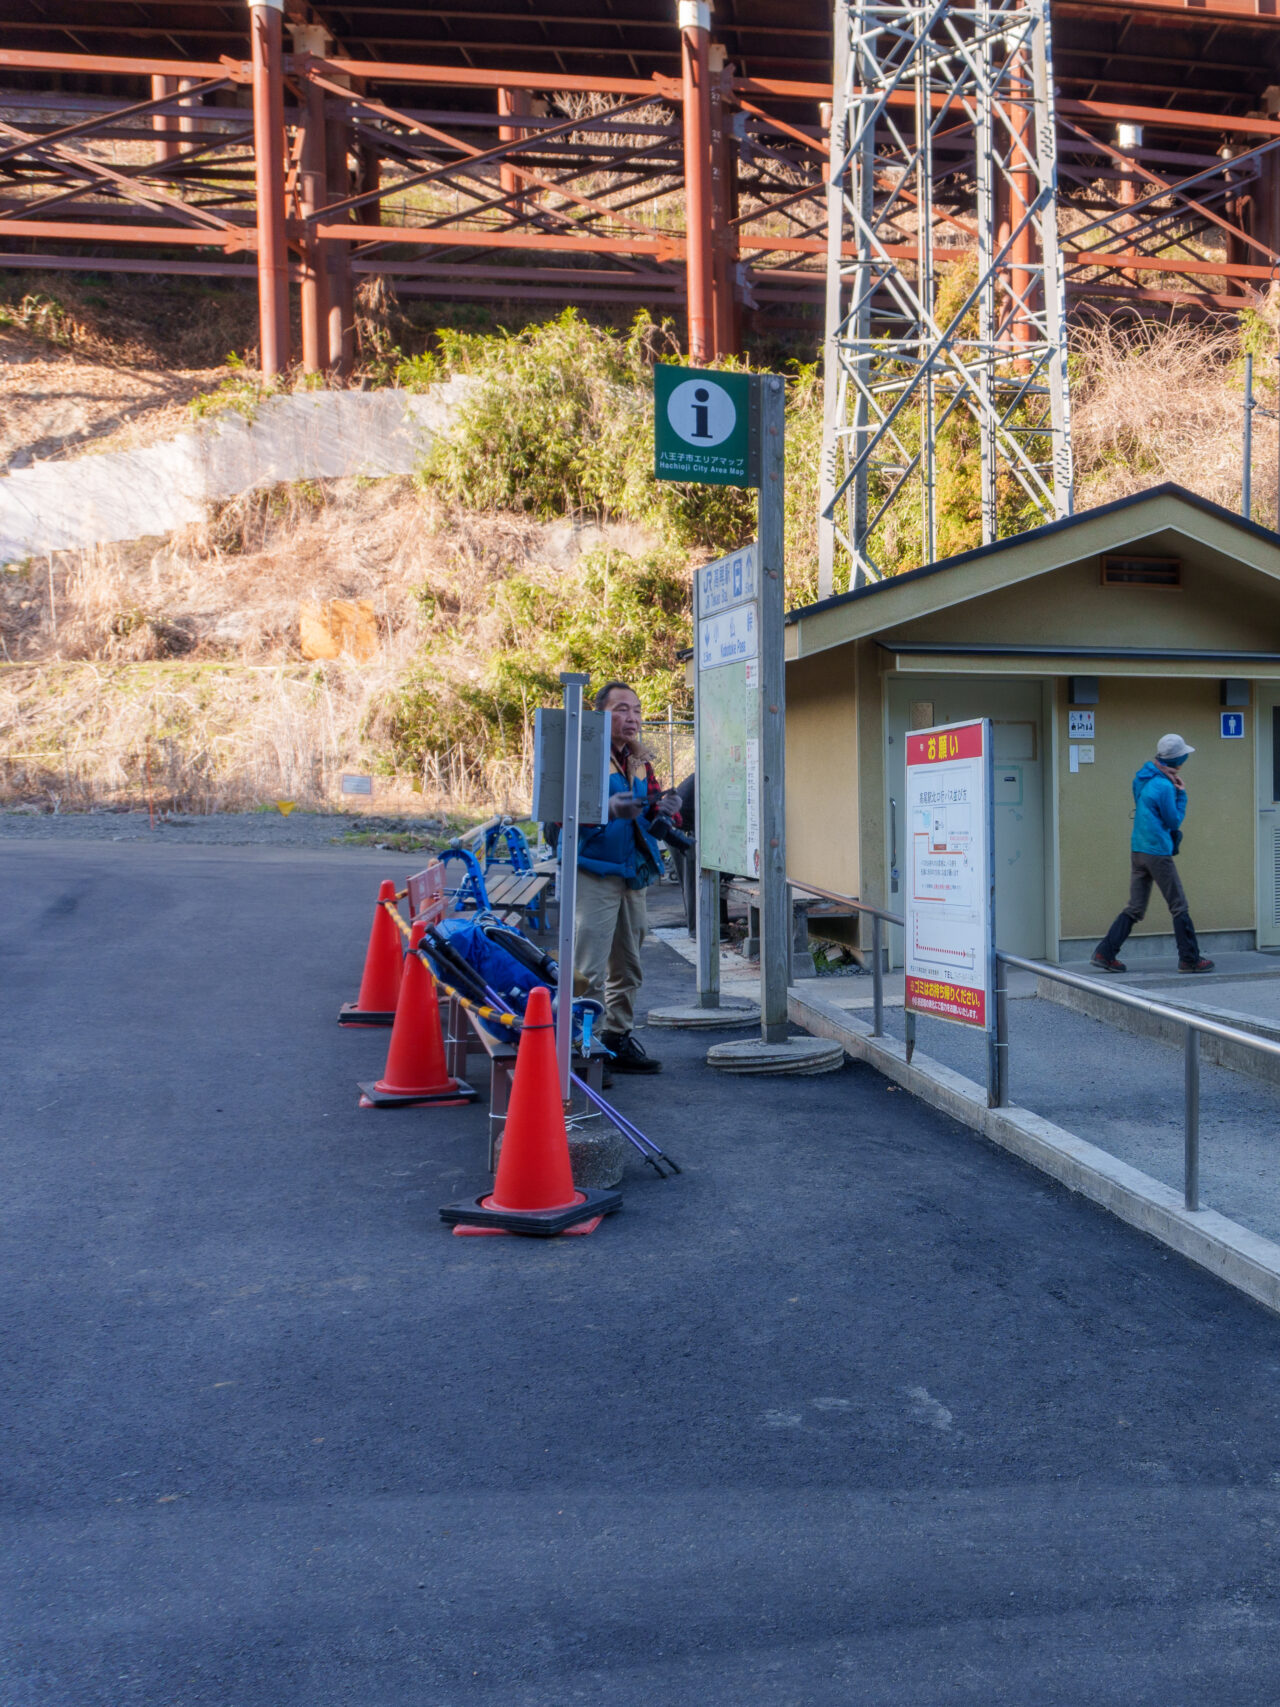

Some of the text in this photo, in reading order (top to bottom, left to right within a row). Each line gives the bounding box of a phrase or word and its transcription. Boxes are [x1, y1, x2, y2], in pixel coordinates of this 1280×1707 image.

[660, 451, 744, 466] 八王子市エリアマップ
[660, 461, 744, 476] Hachioji City Area Map
[928, 735, 959, 760] お願い
